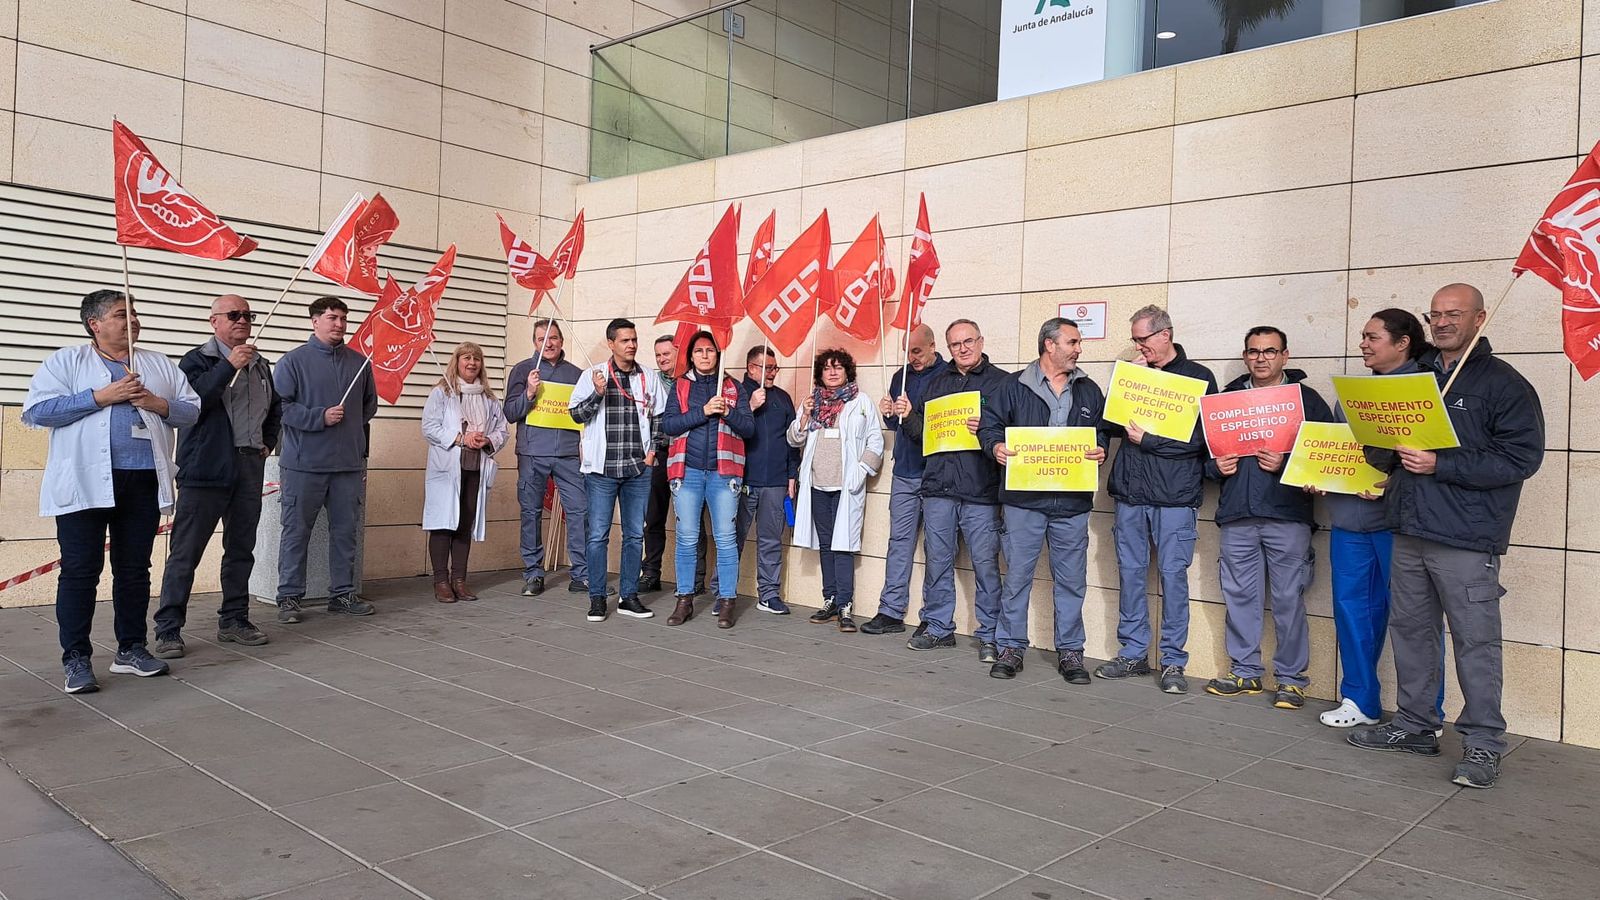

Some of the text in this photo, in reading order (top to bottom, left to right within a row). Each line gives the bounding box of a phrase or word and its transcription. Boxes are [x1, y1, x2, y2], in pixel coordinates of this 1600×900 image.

[1012, 5, 1094, 34] Junta de Andalucía
[1118, 378, 1196, 404] COMPLEMENTO
[1123, 391, 1183, 413] ESPECÍFICO
[1346, 399, 1434, 411] COMPLEMENTO
[927, 407, 974, 422] COMPLEMENTO
[1132, 407, 1167, 421] JUSTO
[1209, 402, 1296, 421] COMPLEMENTO
[1358, 411, 1425, 424] ESPECÍFICO
[930, 418, 967, 431] ESPECÍFICO
[1220, 415, 1287, 432] ESPECÍFICO
[936, 429, 956, 439] JUSTO
[1237, 429, 1274, 442] JUSTO
[1376, 425, 1412, 436] JUSTO
[1013, 444, 1091, 453] COMPLEMENTO
[1023, 453, 1082, 464] ESPECÍFICO
[1036, 467, 1069, 476] JUSTO
[1319, 465, 1356, 476] JUSTO
